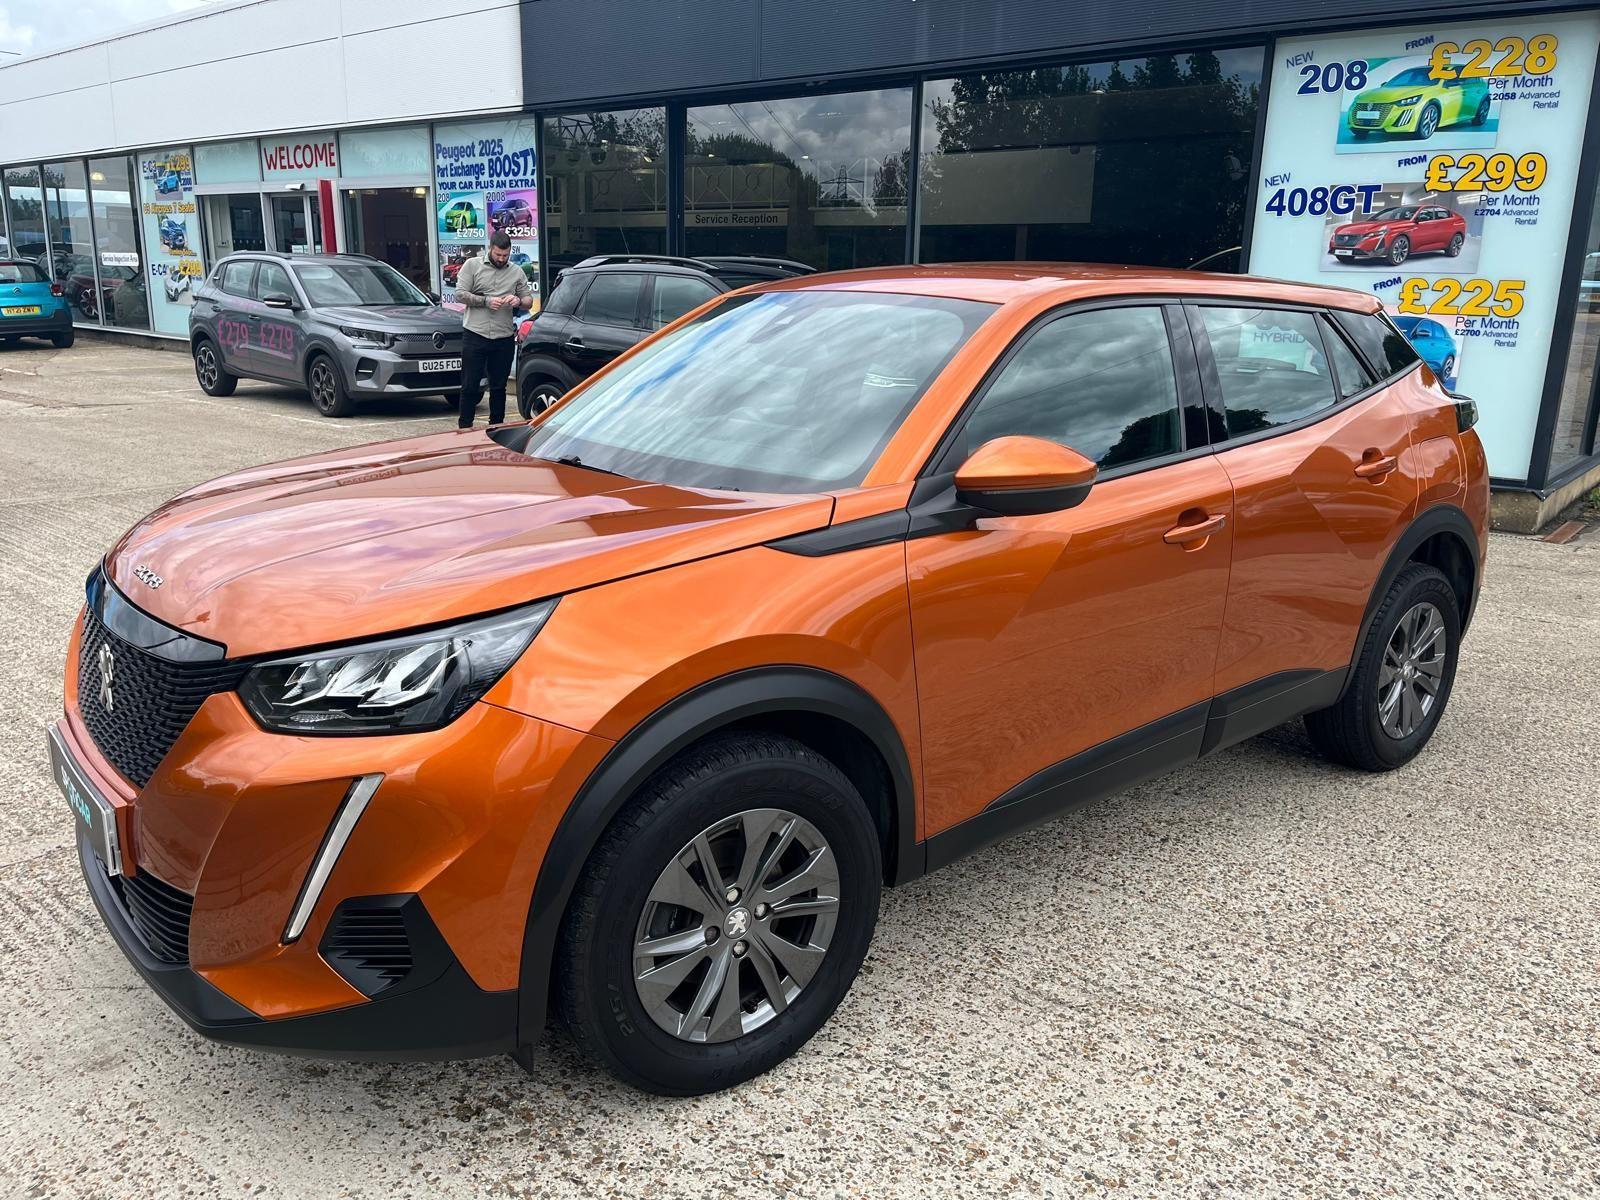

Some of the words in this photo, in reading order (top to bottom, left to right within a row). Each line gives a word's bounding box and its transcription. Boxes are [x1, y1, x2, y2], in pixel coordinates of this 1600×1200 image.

[1286, 50, 1315, 69] NEW
[1405, 35, 1434, 50] FROM
[1428, 34, 1559, 80] £228
[1296, 60, 1368, 96] 208
[1487, 77, 1505, 90] Per
[1506, 76, 1553, 88] Month
[1487, 92, 1517, 101] £2058
[1518, 90, 1561, 100] Advanced
[1533, 100, 1560, 109] Rental
[264, 142, 336, 170] WELCOME
[435, 141, 476, 162] Peugeot
[478, 138, 504, 157] 2025
[437, 164, 448, 178] Part
[449, 161, 485, 180] Exchange
[488, 147, 536, 178] BOOST!
[1398, 155, 1427, 168] FROM
[1424, 152, 1548, 193] £299
[438, 181, 457, 190] YOUR
[458, 181, 473, 190] CAR
[475, 180, 494, 189] PLUS
[496, 180, 507, 189] AN
[508, 178, 536, 188] EXTRA
[1264, 172, 1291, 188] NEW
[438, 192, 450, 203] 208
[487, 191, 506, 202] 2008
[1265, 184, 1383, 217] 408GT
[1479, 194, 1500, 206] Per
[1502, 194, 1540, 206] Month
[1474, 208, 1501, 217] £2704
[1502, 208, 1539, 217] Advanced
[695, 213, 729, 225] Service
[731, 213, 778, 227] Reception
[1514, 217, 1538, 225] Rental
[456, 227, 485, 238] £2750
[505, 226, 537, 238] £3250
[442, 293, 458, 304] 300
[1373, 276, 1402, 291] FROM
[1398, 277, 1526, 318] £225
[1455, 316, 1476, 329] Per
[1481, 317, 1520, 330] Month
[217, 319, 249, 346] £279
[259, 323, 295, 350] £279
[1253, 331, 1306, 344] HYBRID
[1454, 329, 1480, 337] £2700
[1494, 339, 1517, 347] Rental
[422, 360, 445, 371] GU25
[445, 360, 462, 371] FCD
[133, 565, 164, 590] 2008
